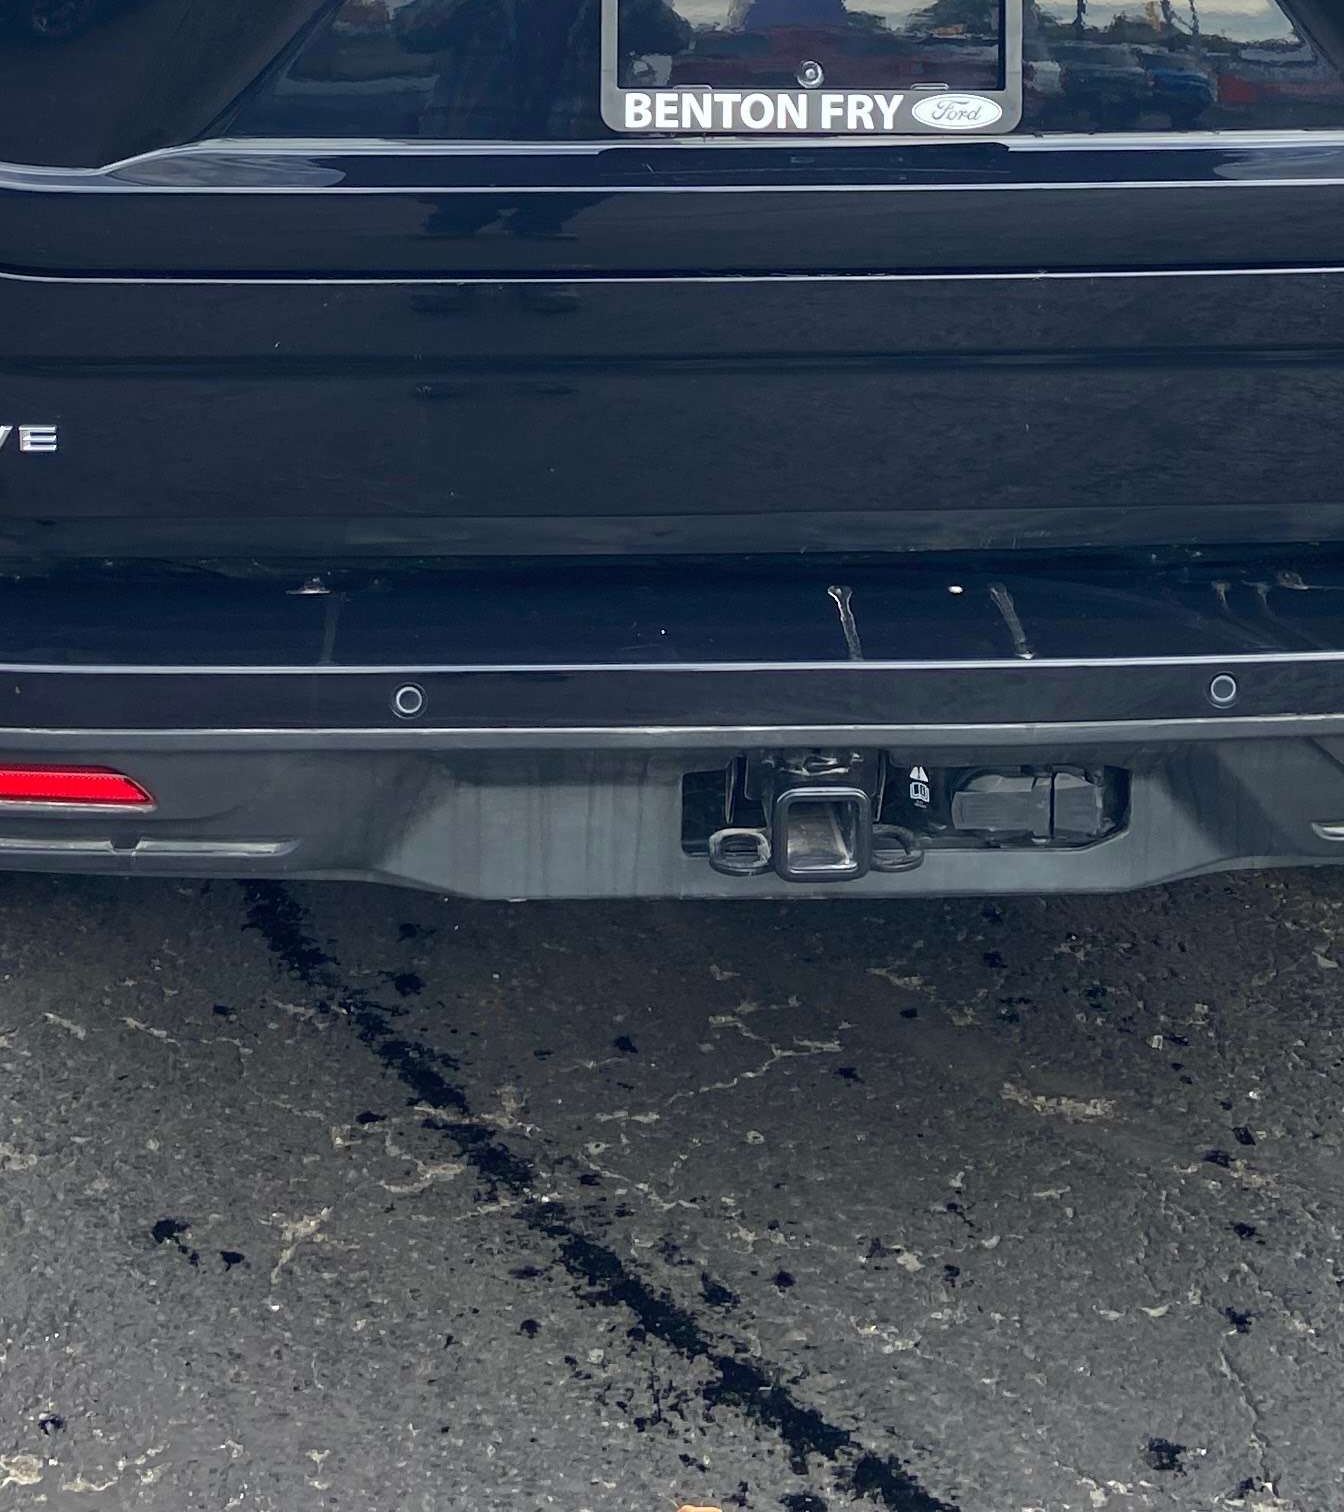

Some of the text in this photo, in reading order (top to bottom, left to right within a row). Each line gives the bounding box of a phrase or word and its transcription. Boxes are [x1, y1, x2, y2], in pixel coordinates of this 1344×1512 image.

[624, 92, 982, 130] BENTON FRY Ford
